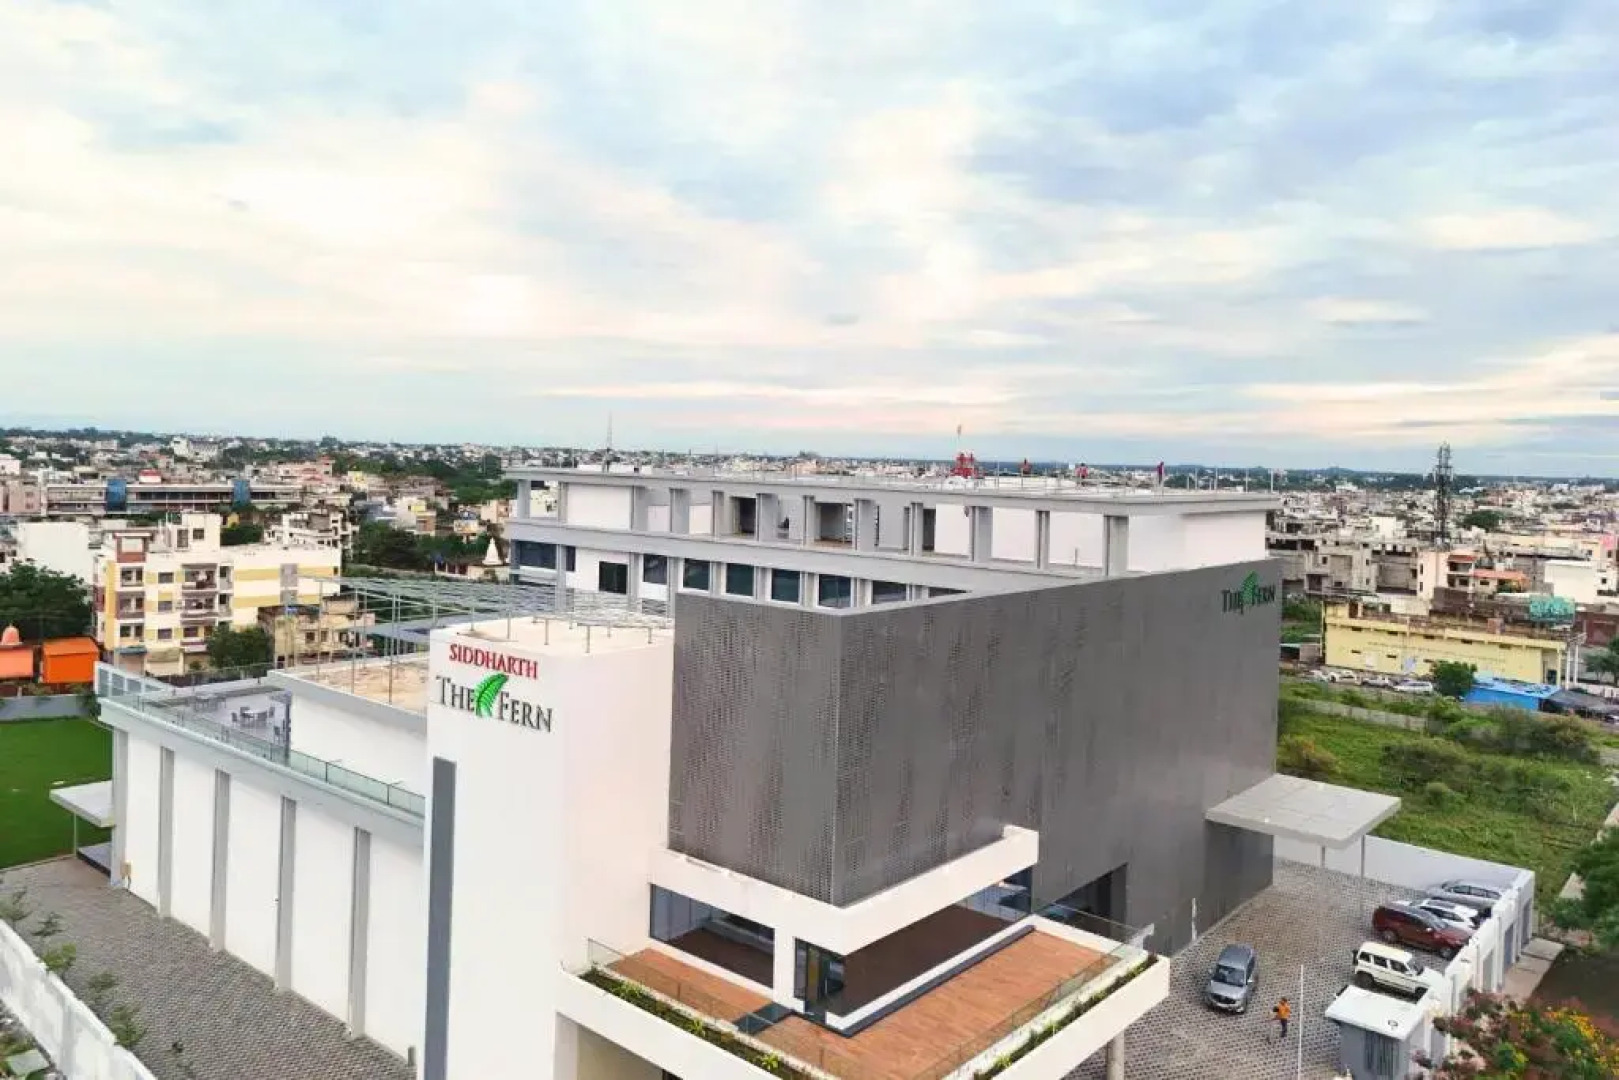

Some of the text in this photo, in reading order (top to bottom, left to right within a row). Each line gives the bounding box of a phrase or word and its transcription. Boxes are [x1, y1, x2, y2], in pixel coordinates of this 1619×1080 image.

[449, 643, 538, 679] SIDDHARTH
[436, 675, 552, 732] THE FERN
